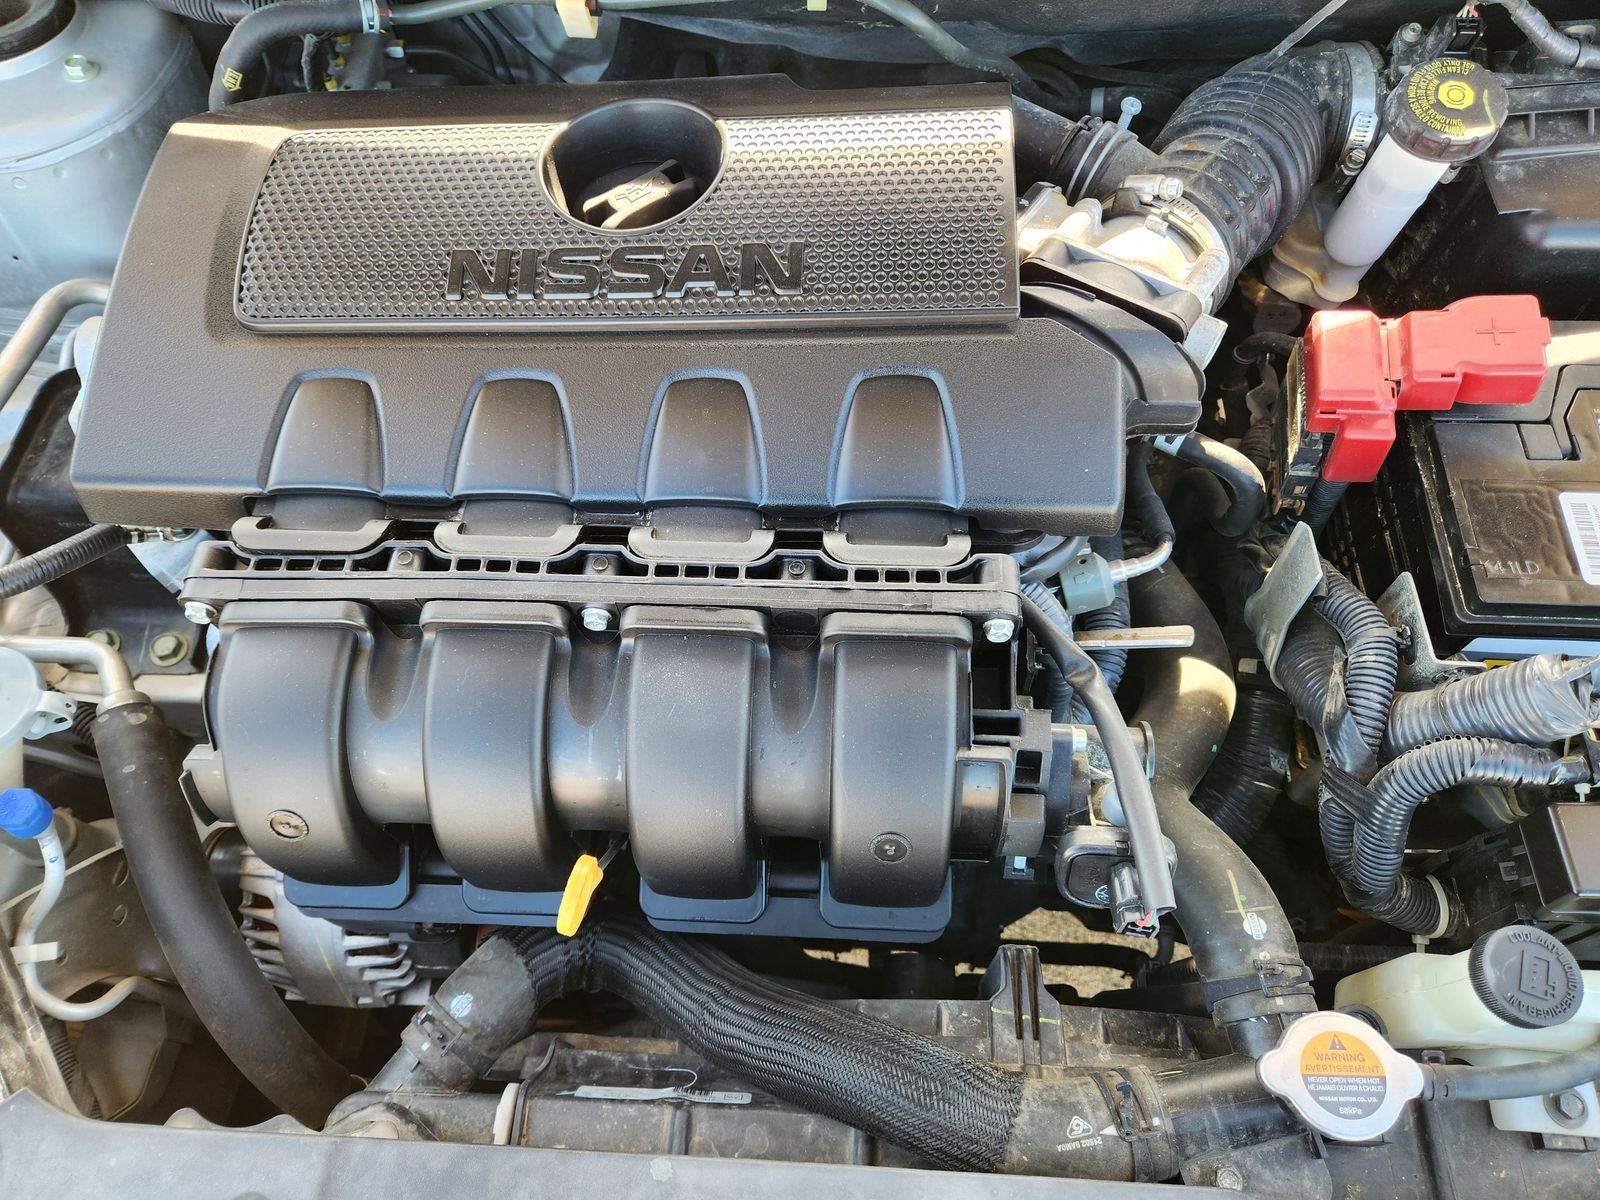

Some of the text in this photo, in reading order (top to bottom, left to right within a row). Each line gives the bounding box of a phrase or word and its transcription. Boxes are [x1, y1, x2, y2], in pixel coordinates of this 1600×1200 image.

[1448, 66, 1469, 75] CLEAN
[1462, 61, 1475, 71] USE
[1425, 67, 1447, 80] FILLER
[1427, 79, 1441, 105] WARNING
[1418, 89, 1431, 111] BEFORE
[1409, 102, 1430, 123] SEALED
[1427, 109, 1463, 127] REMOVING
[1427, 119, 1466, 134] CONTAINER
[444, 241, 805, 300] NISSAN
[1314, 1052, 1366, 1062] WARNING
[1305, 1064, 1380, 1074] AVERTISSEMENT
[1339, 1106, 1363, 1115] 88kPa
